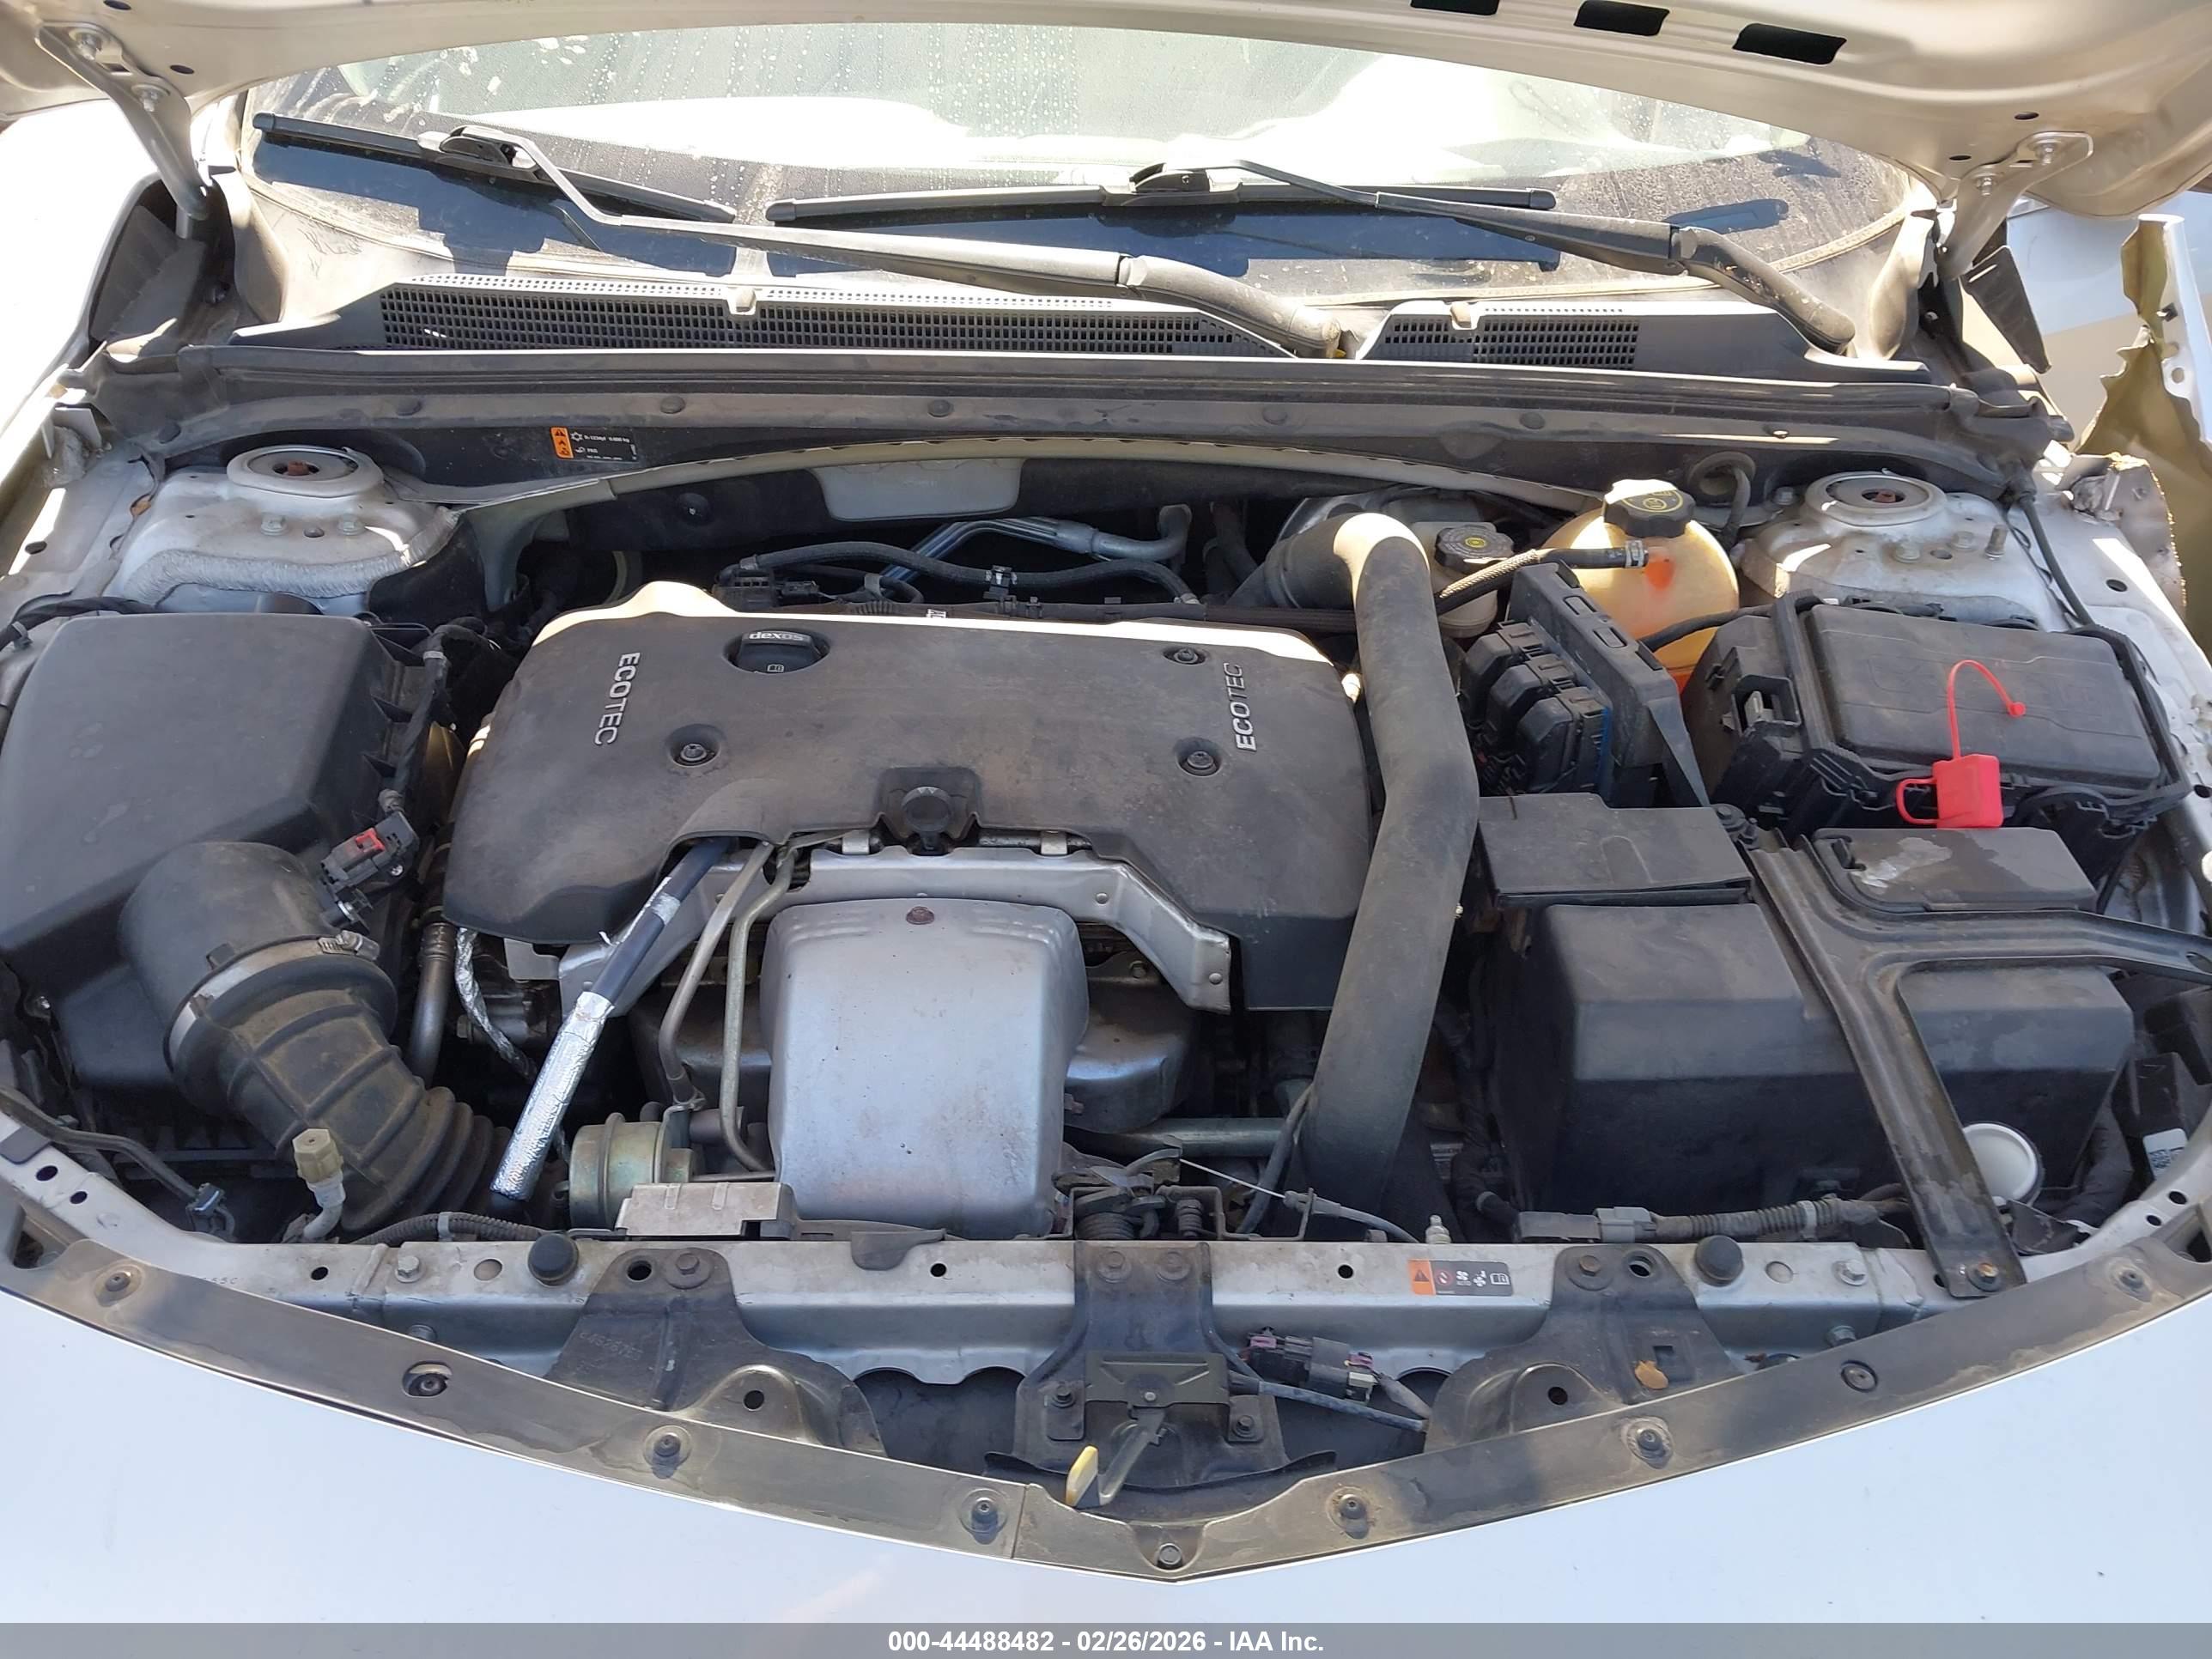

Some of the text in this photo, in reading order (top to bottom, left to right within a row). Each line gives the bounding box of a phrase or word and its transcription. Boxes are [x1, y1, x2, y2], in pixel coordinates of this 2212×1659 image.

[749, 631, 804, 641] dexos
[594, 652, 641, 745] ECOTEC
[1223, 662, 1257, 751] ECOTEC
